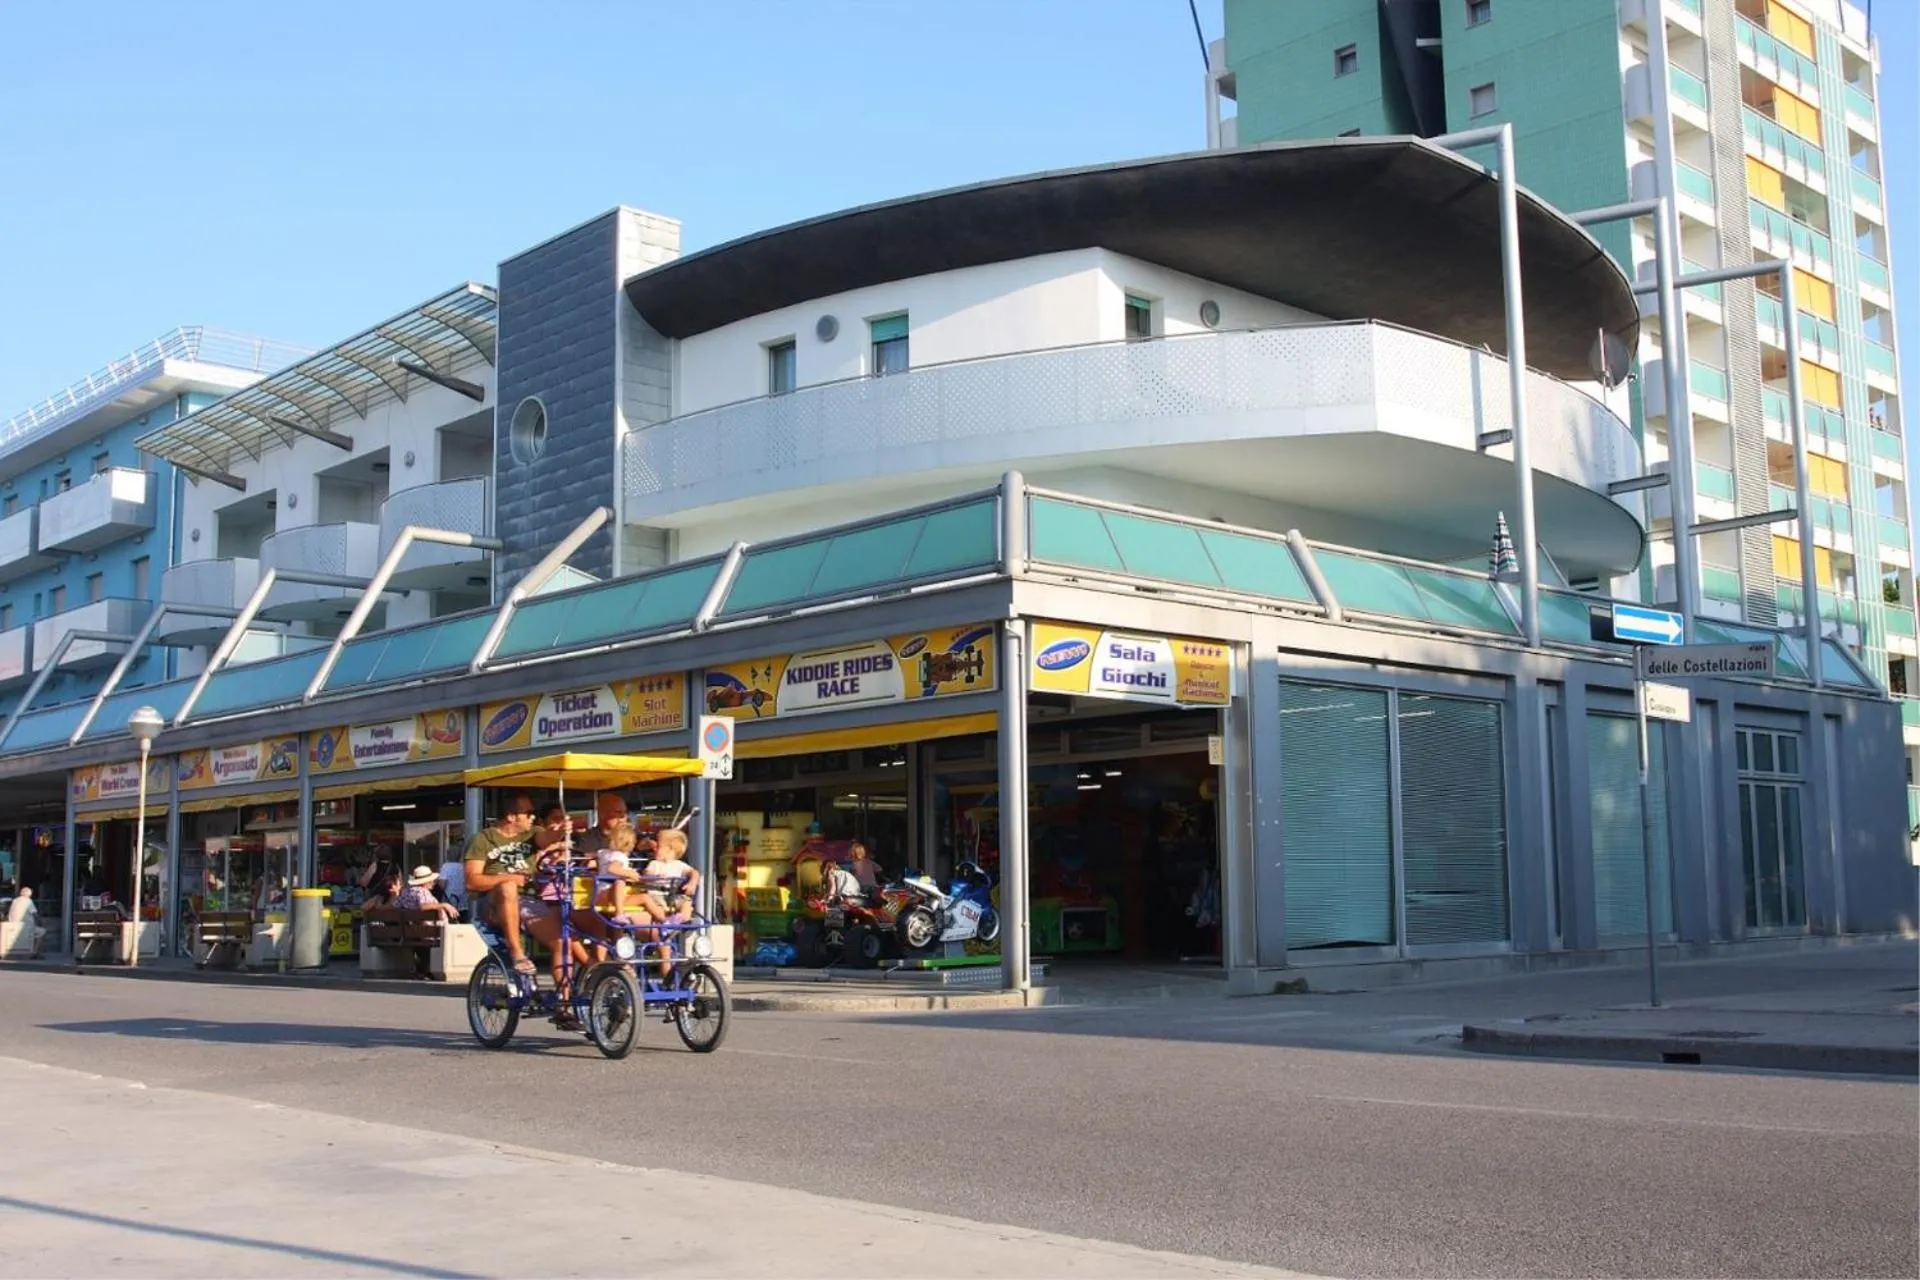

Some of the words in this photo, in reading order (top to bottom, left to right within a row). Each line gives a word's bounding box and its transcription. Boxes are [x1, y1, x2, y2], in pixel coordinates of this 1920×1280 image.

[1109, 643, 1156, 663] Sala
[786, 661, 840, 685] KIDDIE
[843, 653, 893, 677] RIDES
[1648, 660, 1678, 674] delle
[1683, 657, 1767, 673] Costellazioni
[817, 677, 860, 699] RACE
[1101, 667, 1167, 688] Giochi
[553, 693, 597, 715] Ticket
[643, 697, 667, 712] Slot
[538, 711, 613, 738] Operation
[631, 712, 681, 729] Machine
